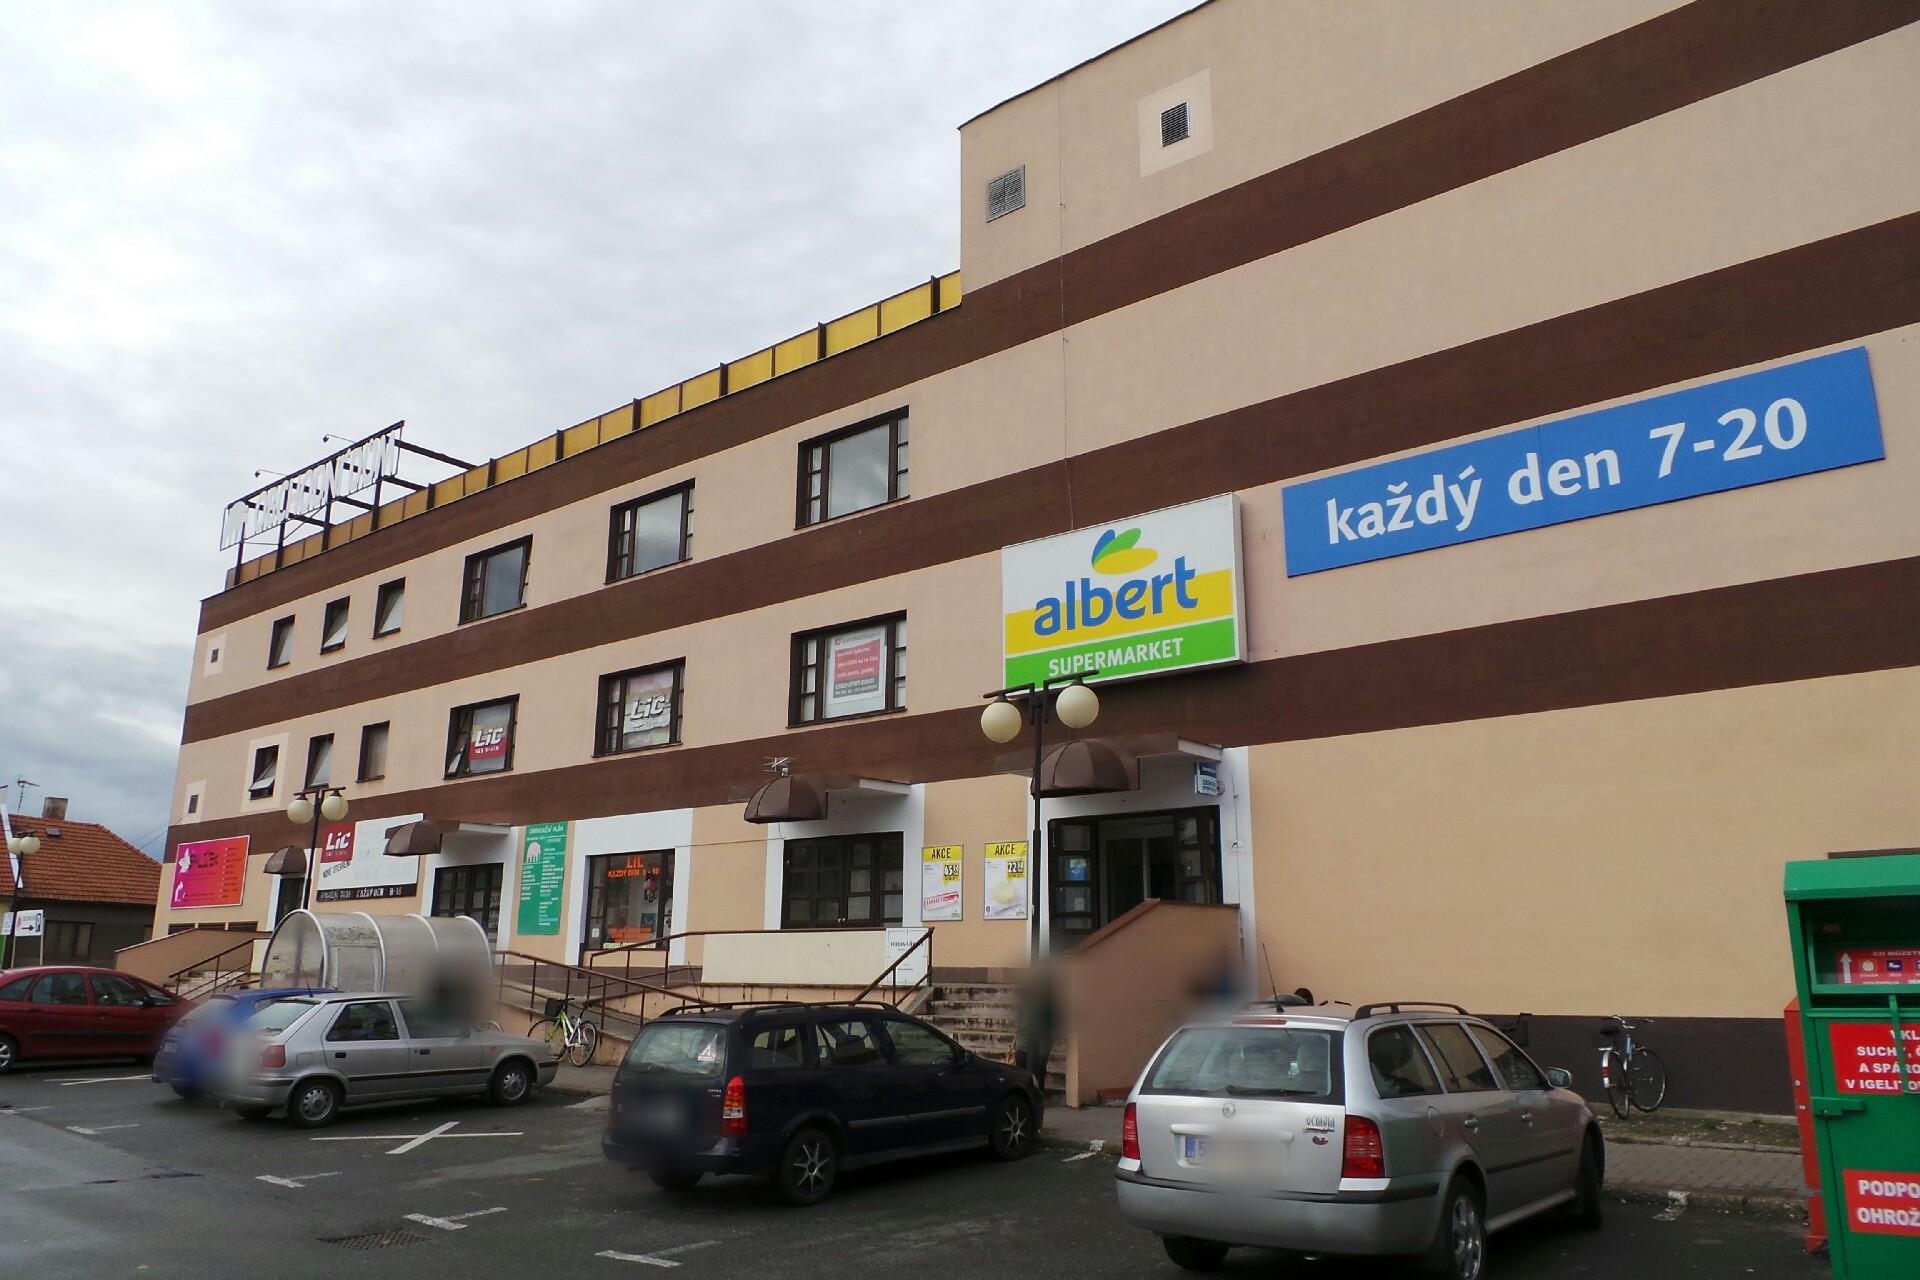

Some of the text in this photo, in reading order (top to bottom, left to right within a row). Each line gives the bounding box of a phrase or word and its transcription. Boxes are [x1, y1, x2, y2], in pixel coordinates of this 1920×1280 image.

[1326, 397, 1808, 545] každý den 7-20
[1033, 555, 1199, 637] albert
[1048, 637, 1184, 678] SUPERMARKET
[931, 847, 952, 860] AKCE
[995, 844, 1016, 856] AKCE
[1860, 1063, 1870, 1073] A
[1846, 1079, 1856, 1089] V
